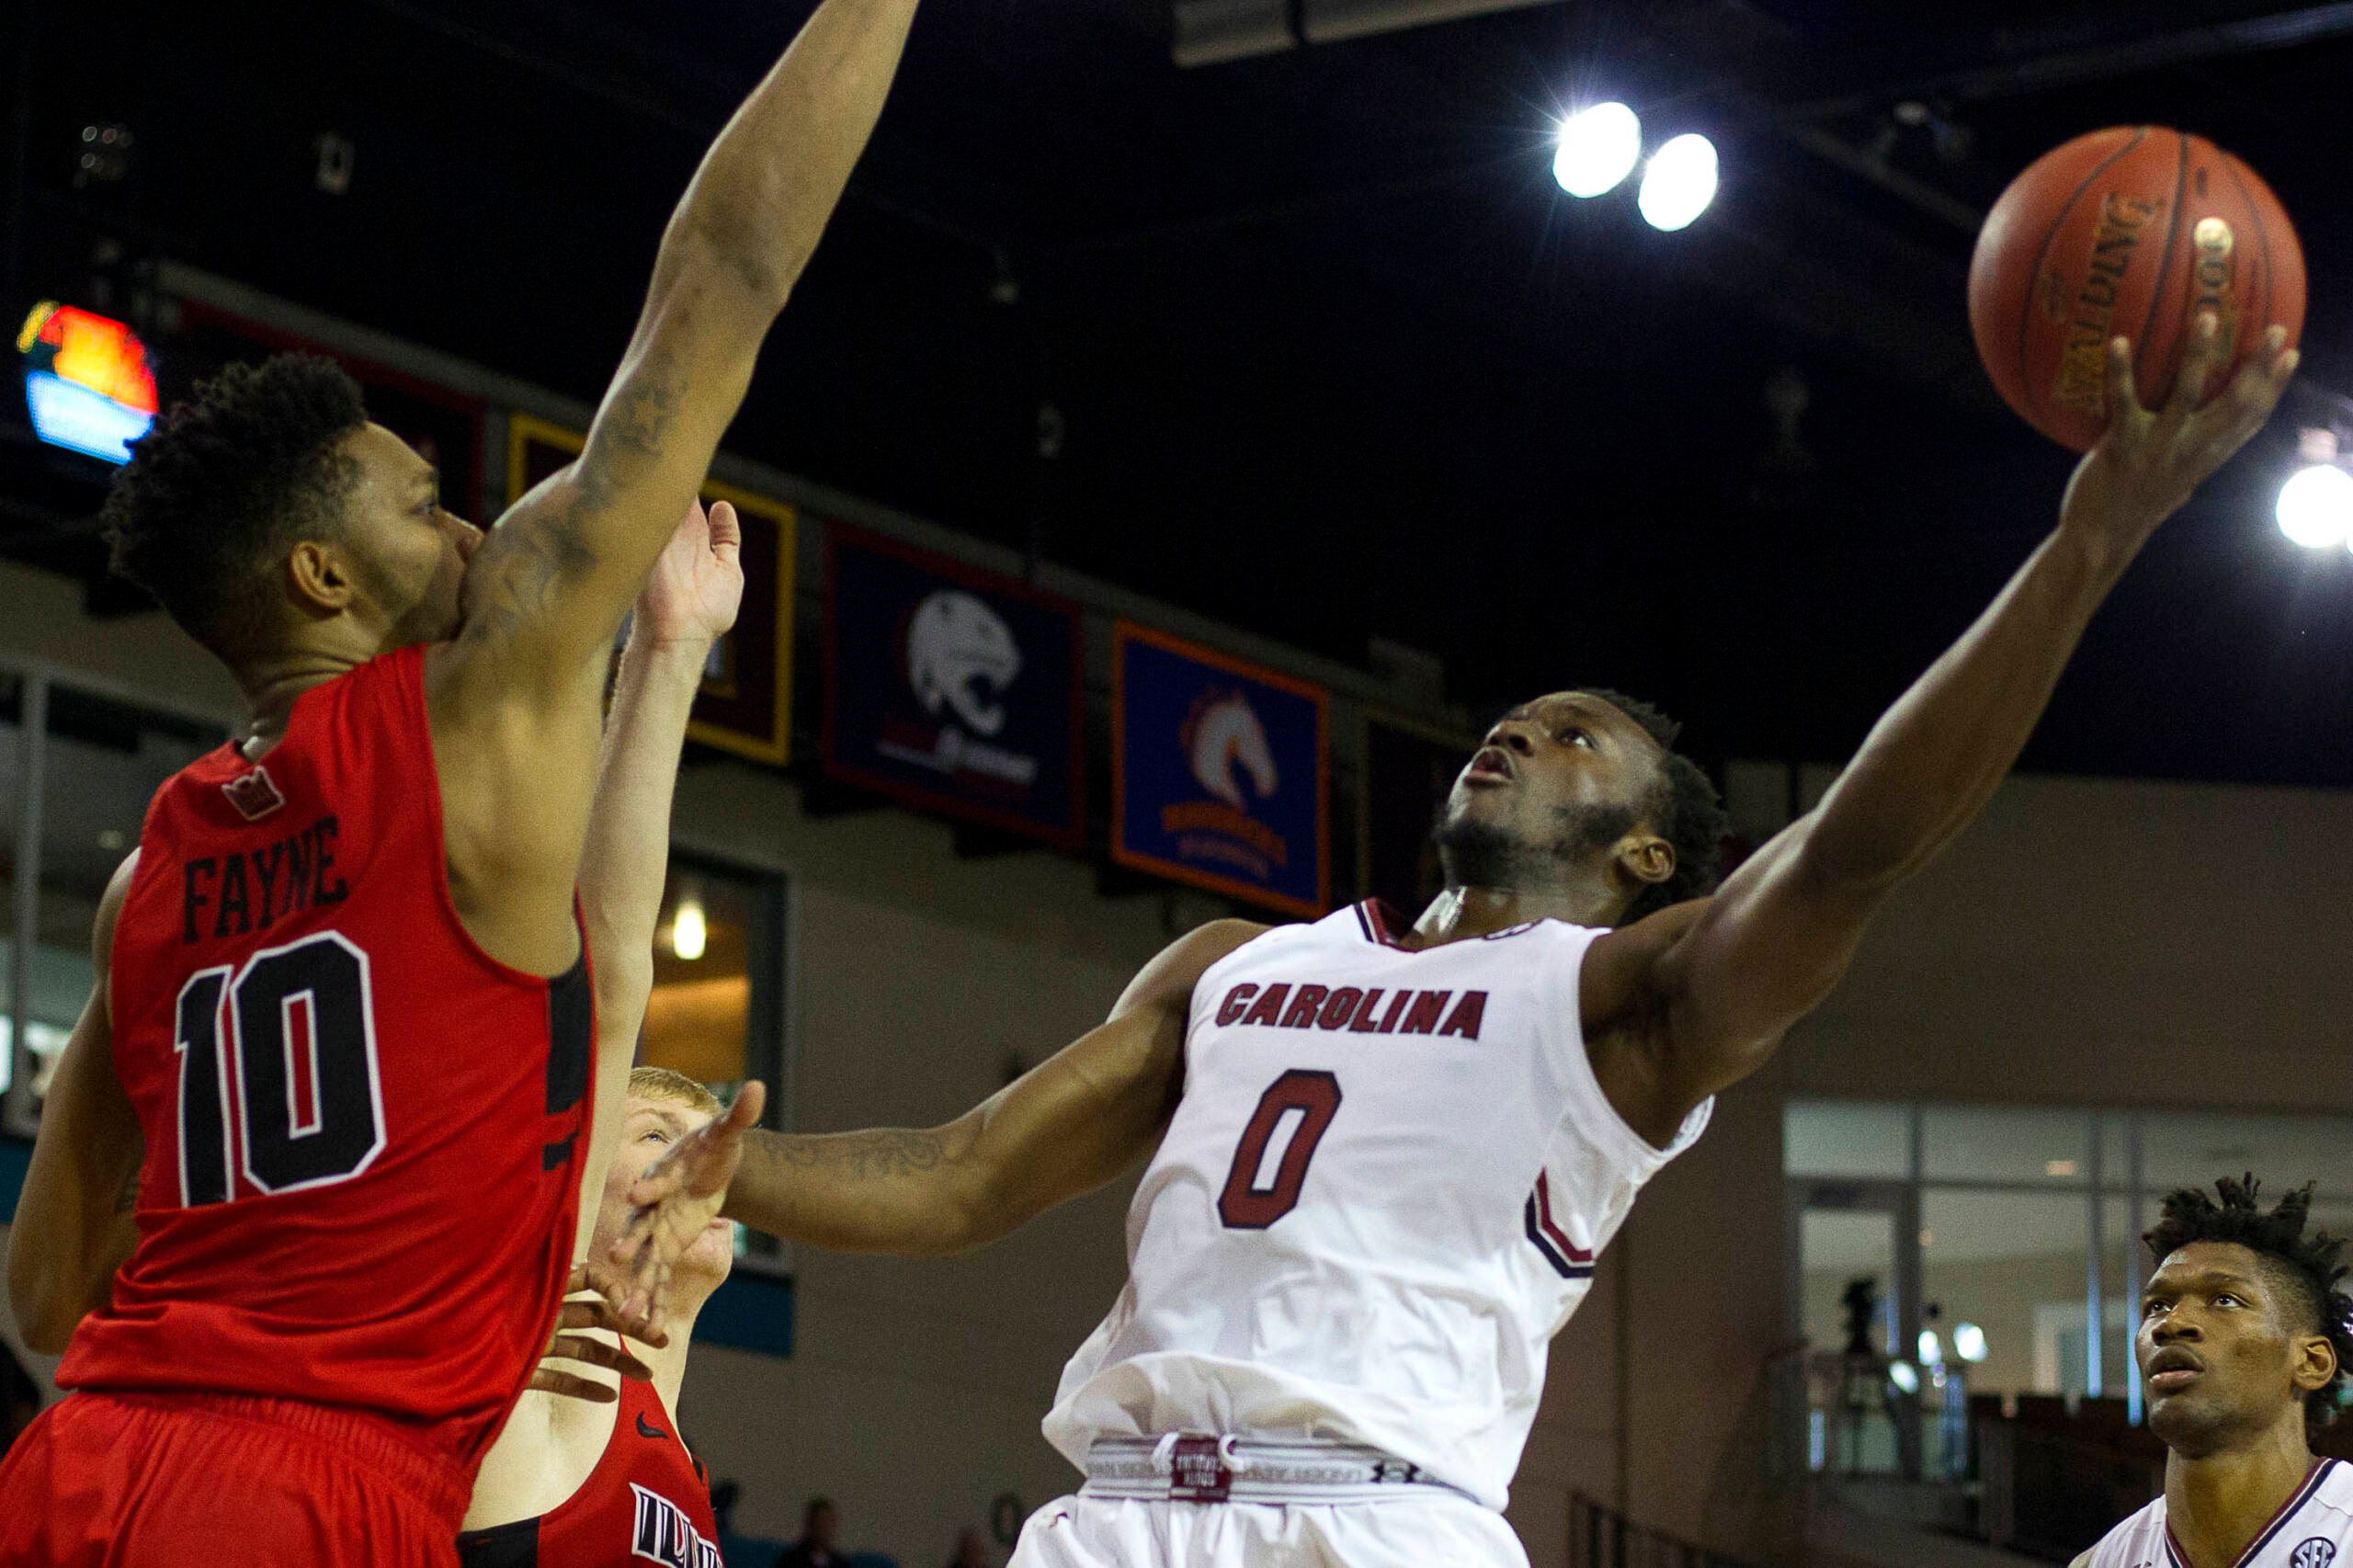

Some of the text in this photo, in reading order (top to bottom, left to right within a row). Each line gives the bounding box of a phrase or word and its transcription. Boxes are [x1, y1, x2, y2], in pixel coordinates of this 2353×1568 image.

[184, 815, 349, 944] FAYNE
[175, 928, 387, 1210] 10
[1215, 982, 1489, 1041] CAROLINA
[1218, 1068, 1342, 1231] 0
